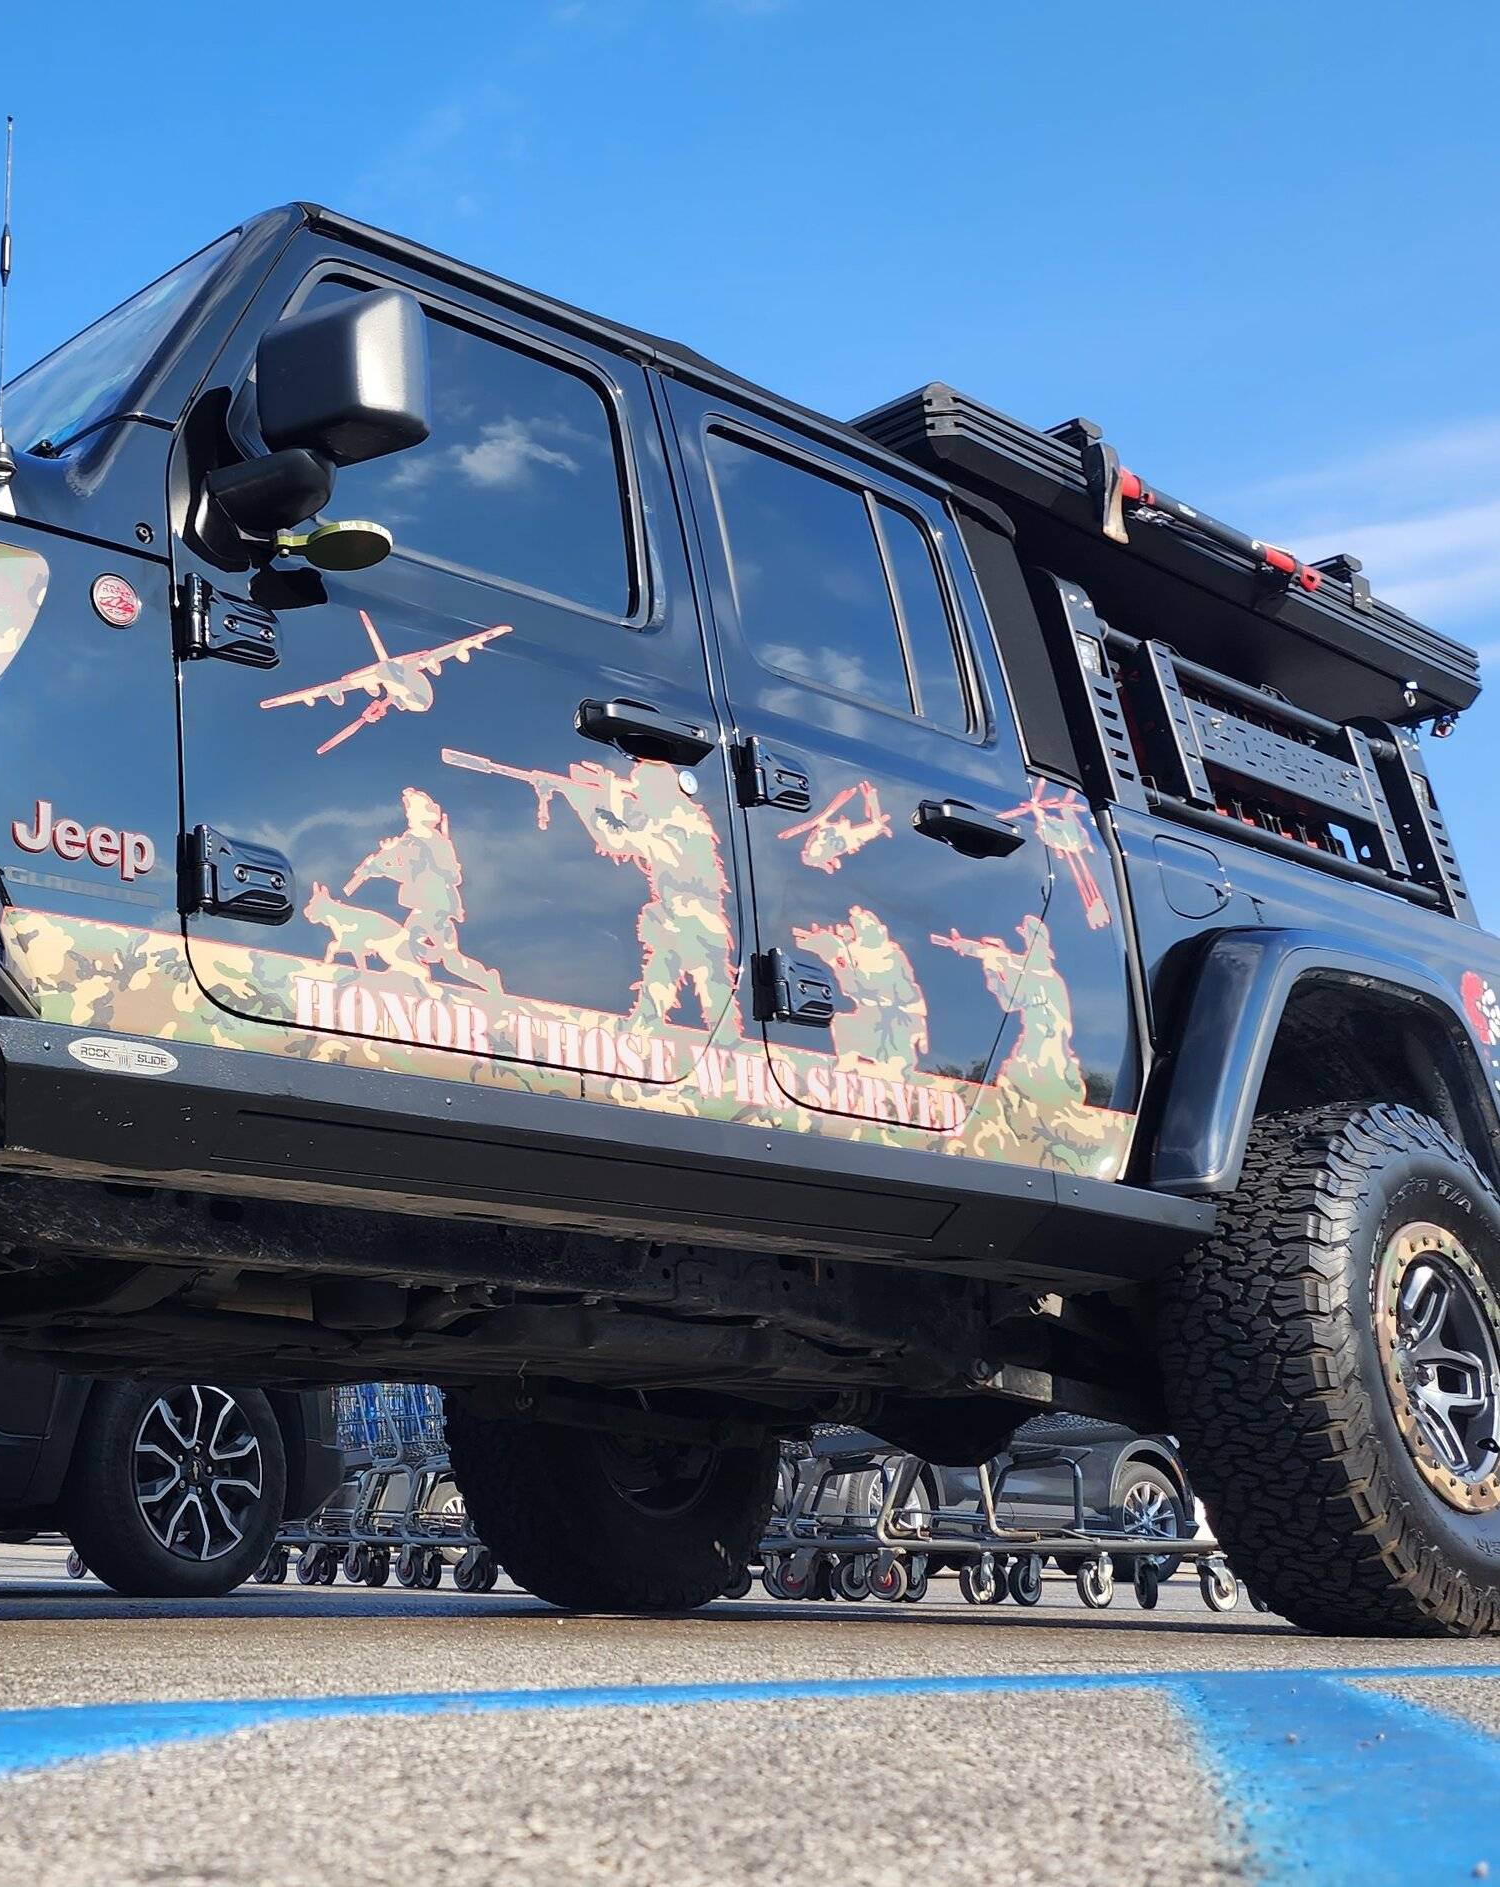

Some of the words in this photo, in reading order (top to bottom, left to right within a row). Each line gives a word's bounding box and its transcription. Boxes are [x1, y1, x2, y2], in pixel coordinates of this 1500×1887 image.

[11, 800, 155, 882] Jeep
[80, 1045, 112, 1059] ROCK
[137, 1052, 168, 1067] SLIDE
[294, 975, 492, 1057] HONOR
[506, 1013, 676, 1085] THOSE
[690, 1045, 797, 1111] WHO
[804, 1065, 969, 1137] SERVED
